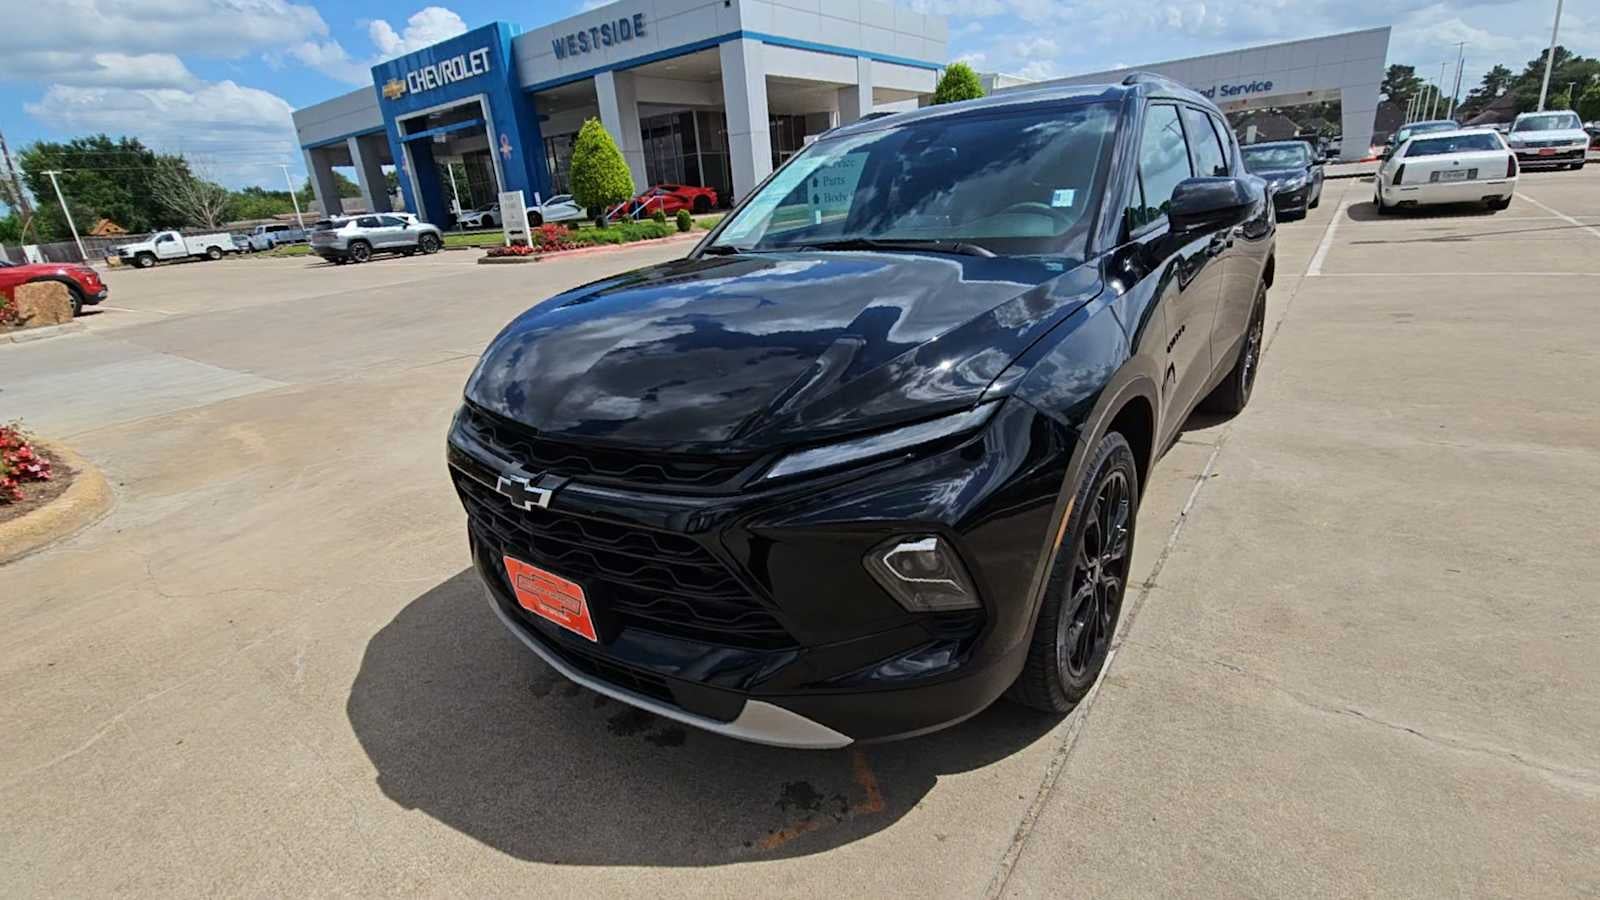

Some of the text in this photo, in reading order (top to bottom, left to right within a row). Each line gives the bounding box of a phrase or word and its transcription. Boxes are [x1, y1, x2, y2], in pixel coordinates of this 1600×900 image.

[551, 12, 646, 61] WESTSIDE
[406, 47, 492, 94] CHEVROLET
[1220, 80, 1273, 97] Service
[823, 175, 847, 187] Parts
